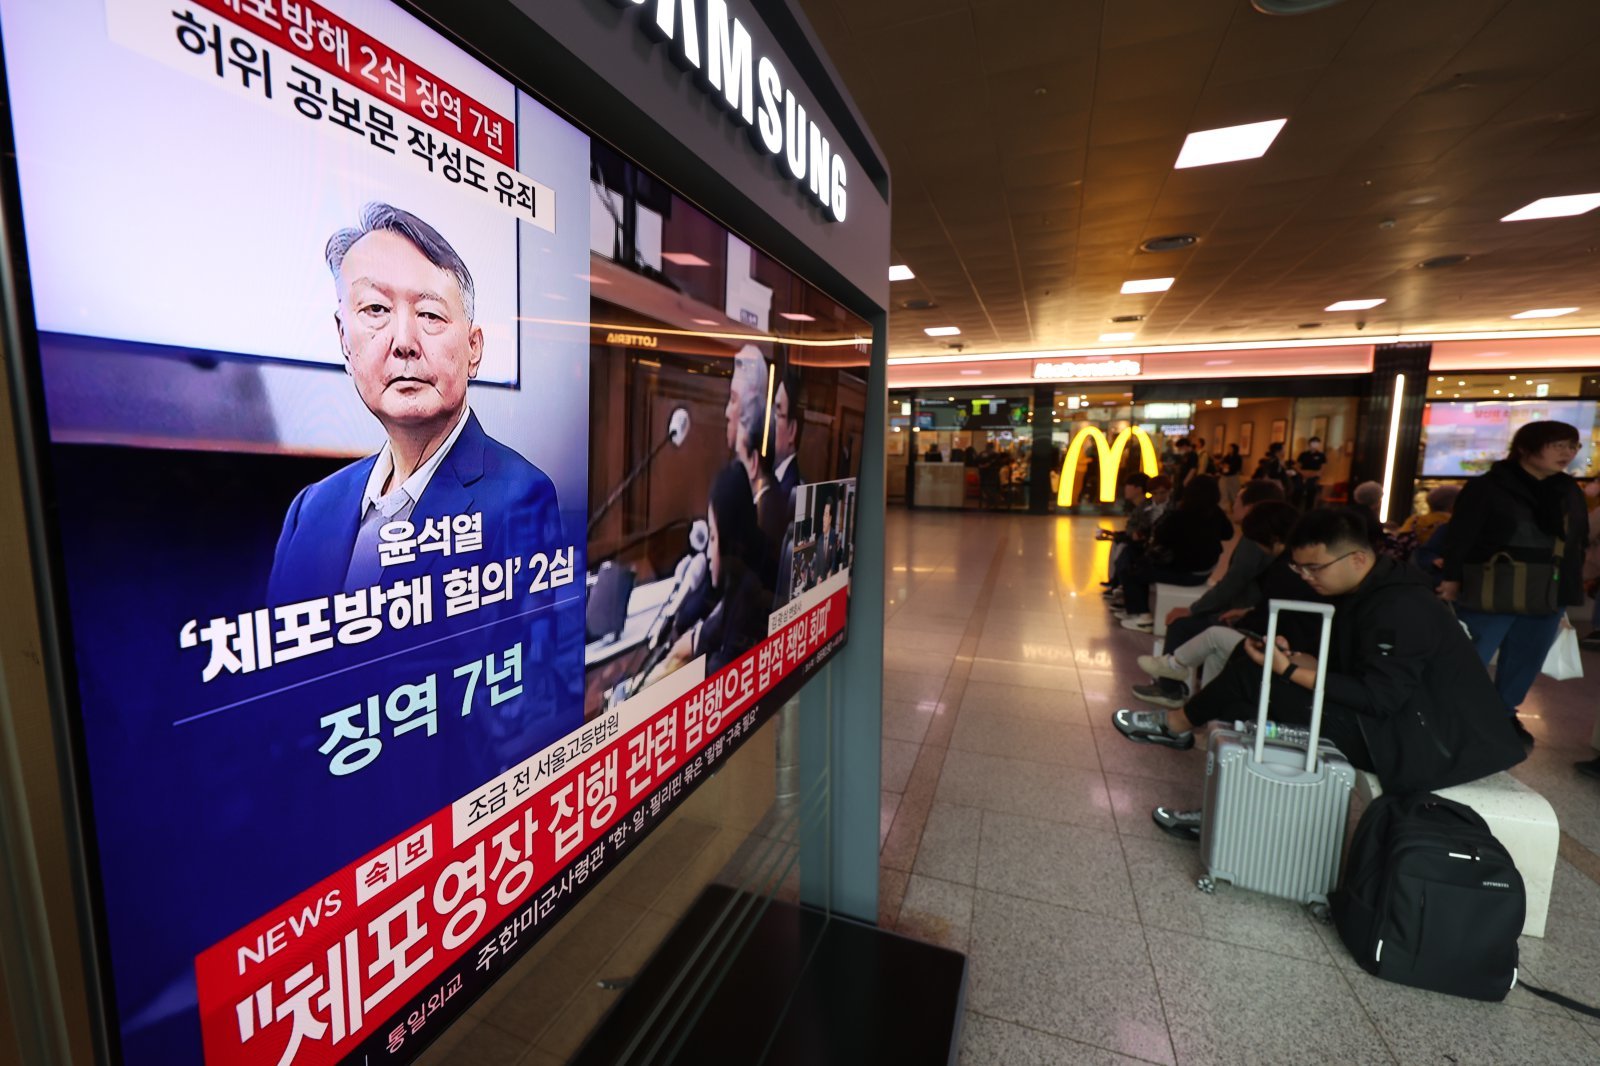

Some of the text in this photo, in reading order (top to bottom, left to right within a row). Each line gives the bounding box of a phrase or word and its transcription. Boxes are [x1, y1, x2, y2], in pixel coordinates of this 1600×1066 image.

[171, 10, 537, 218] 허위 공보문 작성도 유죄
[222, 0, 504, 155] 포방해 2심 징역 7년
[376, 511, 483, 567] 윤석열
[528, 545, 575, 593] 2심
[318, 641, 524, 777] 징역 7년
[547, 749, 618, 863] 집행
[626, 707, 678, 799] 관련
[684, 656, 754, 754] 범행으로
[758, 632, 784, 692] 법적
[786, 615, 808, 664] 책임
[467, 712, 619, 827] 조금 전 서울고등법원
[364, 829, 430, 890] 속보
[475, 841, 605, 971] 주한미군사령관
[684, 757, 703, 785] 묶은
[726, 722, 742, 746] 구축
[237, 889, 342, 975] NEWS
[386, 973, 463, 1054] 통일외교
